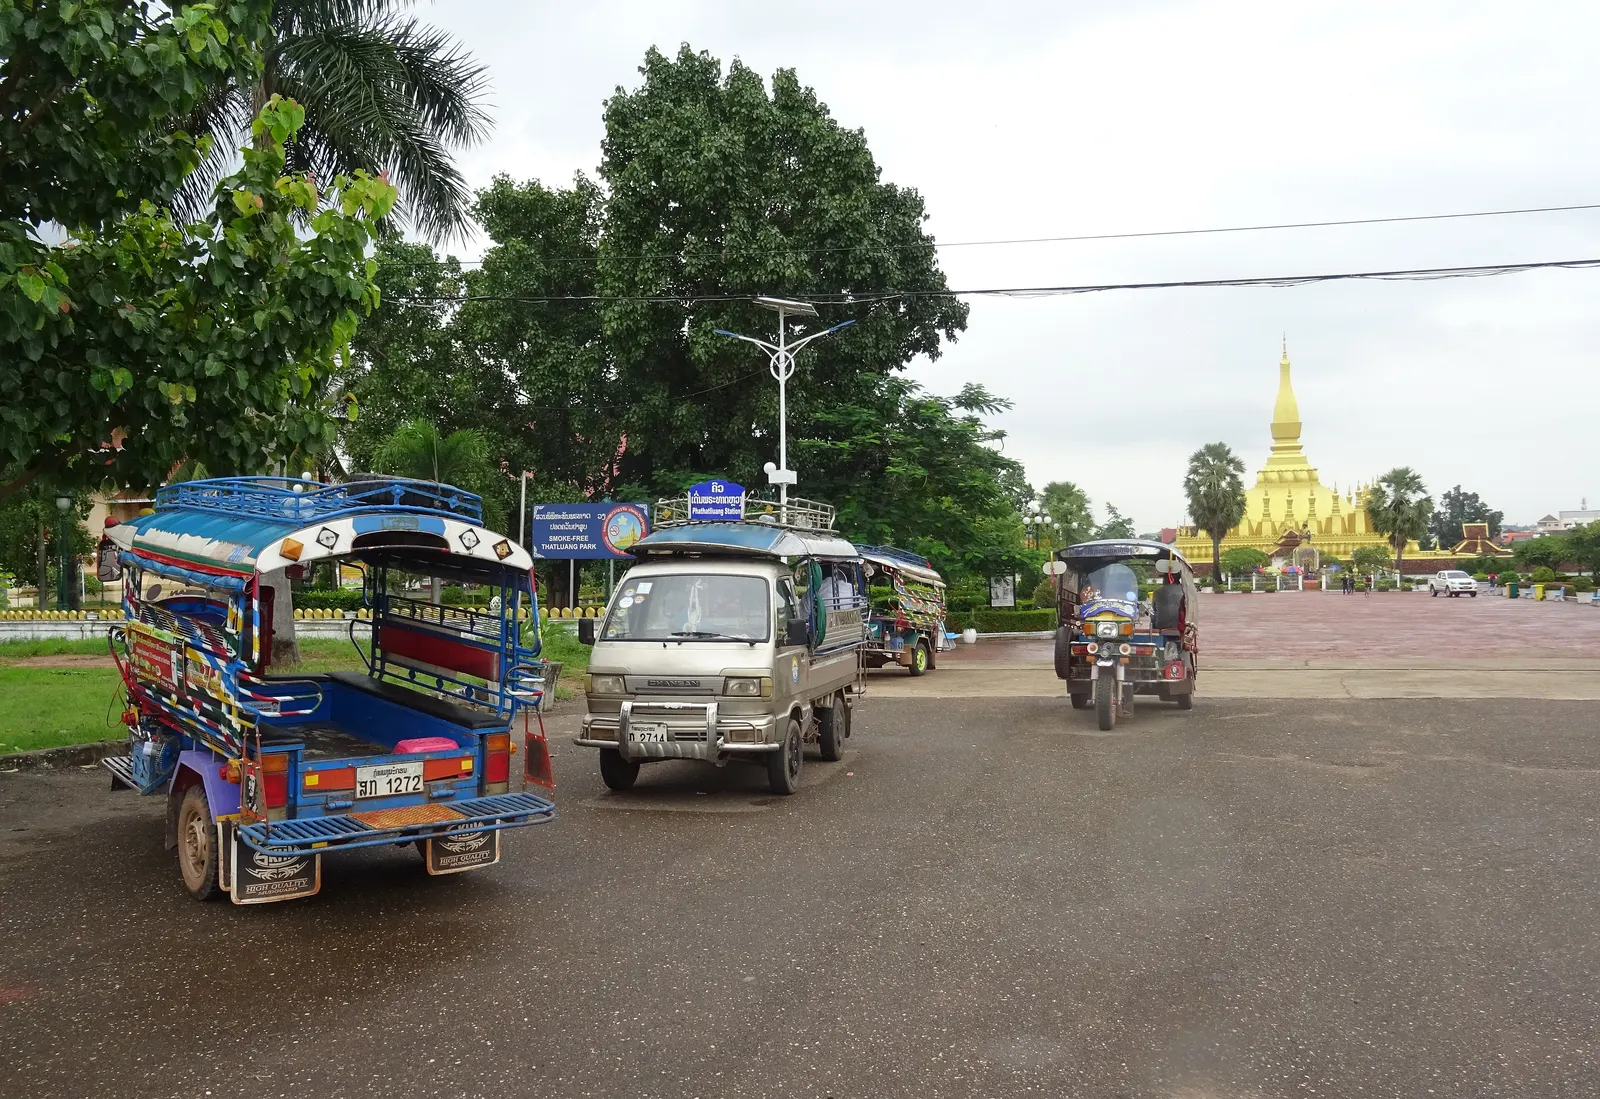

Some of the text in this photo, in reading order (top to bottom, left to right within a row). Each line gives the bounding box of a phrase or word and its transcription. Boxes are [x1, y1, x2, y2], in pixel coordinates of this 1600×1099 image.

[724, 507, 741, 515] Station
[386, 775, 421, 793] 1272
[440, 852, 489, 865] HIGH QUALITY
[246, 880, 308, 893] HIGH QUALITY
